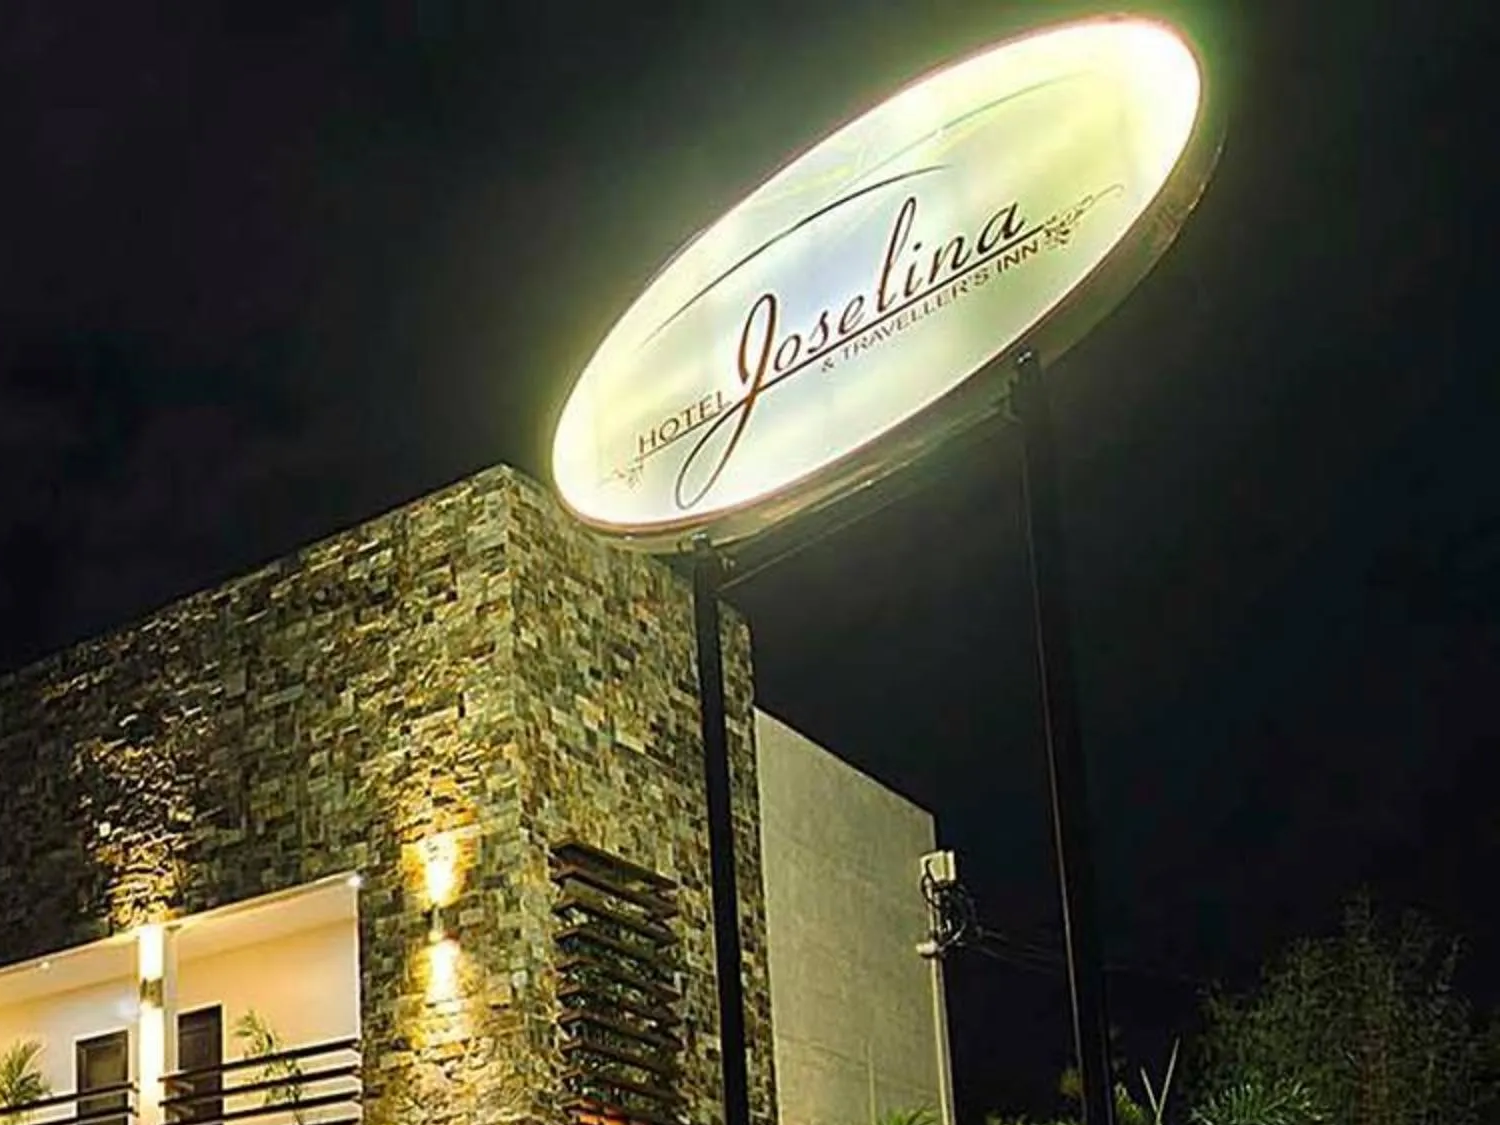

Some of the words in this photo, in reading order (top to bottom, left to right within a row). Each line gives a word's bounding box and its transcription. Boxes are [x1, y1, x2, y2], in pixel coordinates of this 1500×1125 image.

[675, 196, 1025, 510] Joselina
[821, 356, 836, 373] &
[997, 239, 1038, 273] INN
[638, 390, 733, 455] HOTEL
